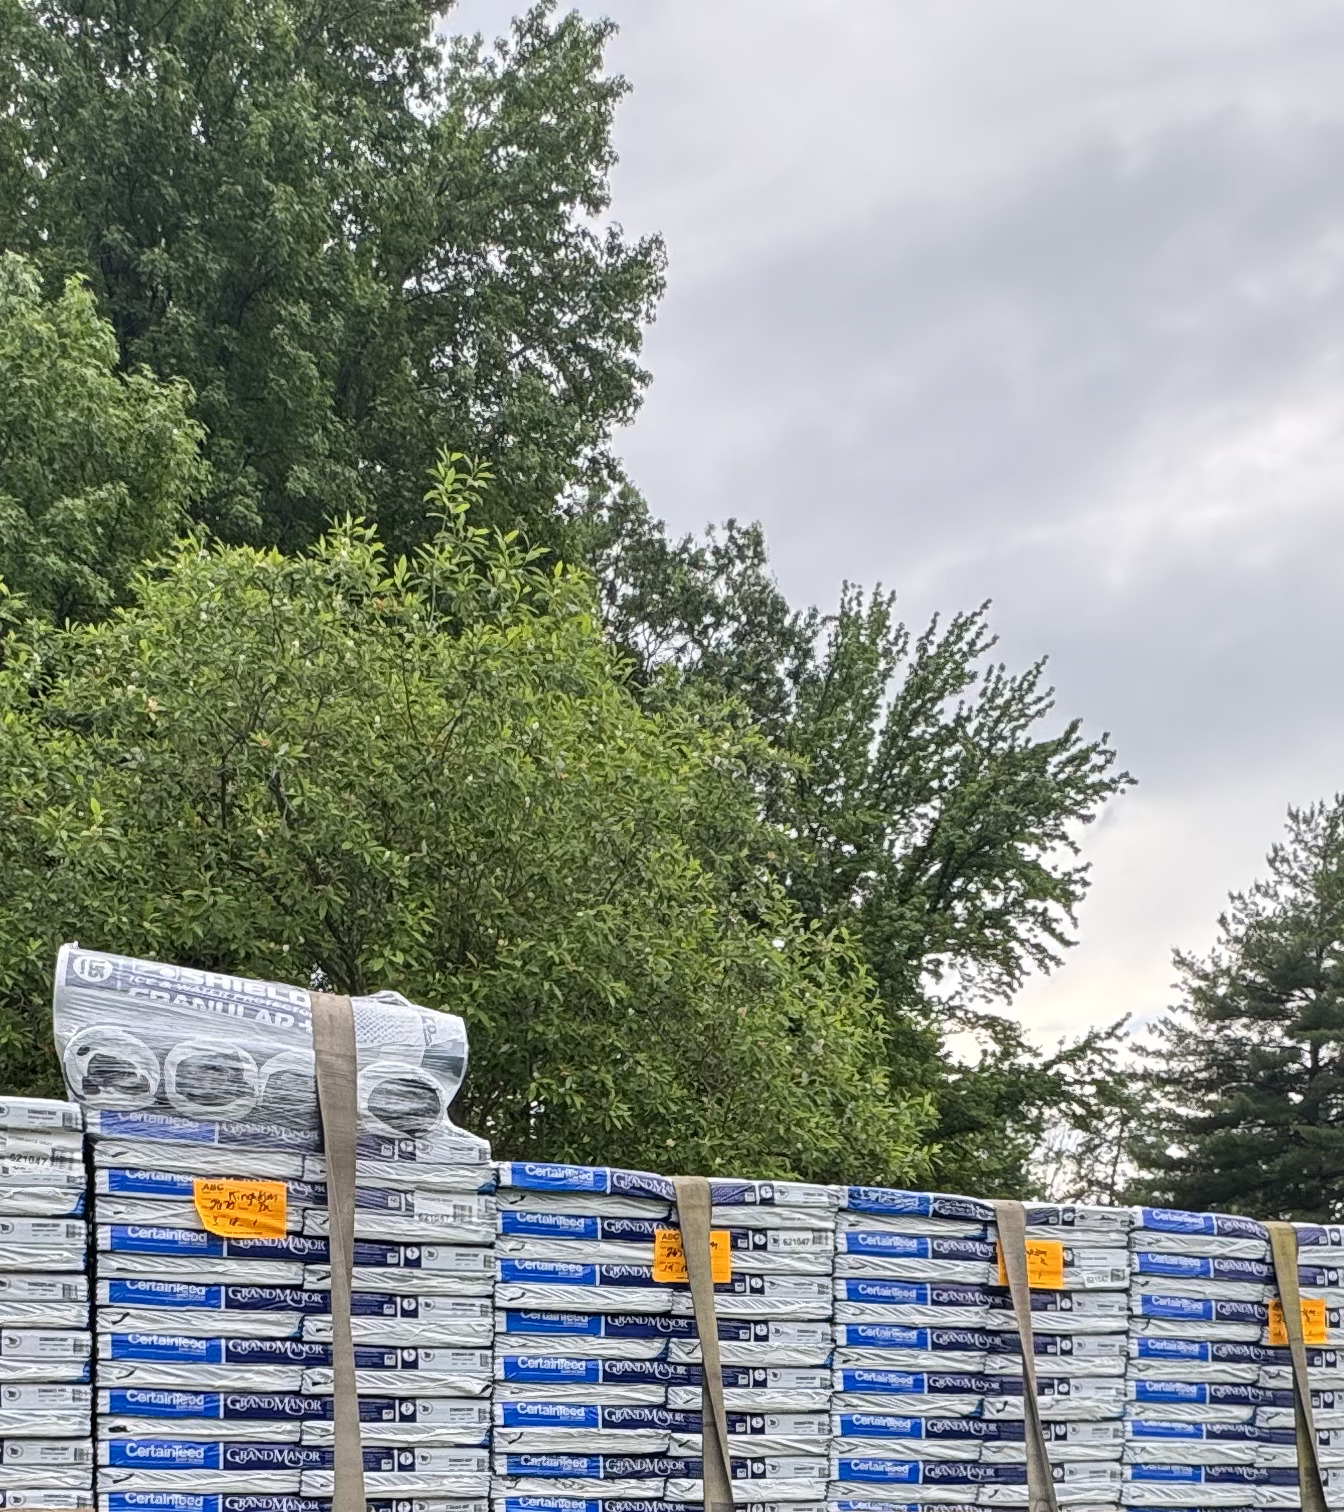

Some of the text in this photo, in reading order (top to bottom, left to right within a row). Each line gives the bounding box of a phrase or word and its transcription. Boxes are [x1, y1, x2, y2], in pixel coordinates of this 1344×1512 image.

[224, 991, 313, 1018] PROTECTO
[516, 1212, 585, 1229] CertainTeed
[126, 1225, 207, 1244] CertainTeed
[858, 1234, 917, 1249] CertainTeed
[858, 1285, 917, 1298] CertainTeed
[857, 1326, 917, 1341] CertainTeed
[128, 1333, 207, 1350] CertainTeed
[517, 1356, 586, 1371] CertainTeed
[855, 1370, 914, 1385] CertainTeed
[126, 1388, 205, 1406] CertainTeed
[516, 1402, 585, 1417] CertainTeed
[852, 1414, 911, 1429] CertainTeed
[126, 1443, 205, 1460] CertainTeed
[850, 1459, 909, 1473] CertainTeed
[126, 1492, 204, 1508] CertainTeed
